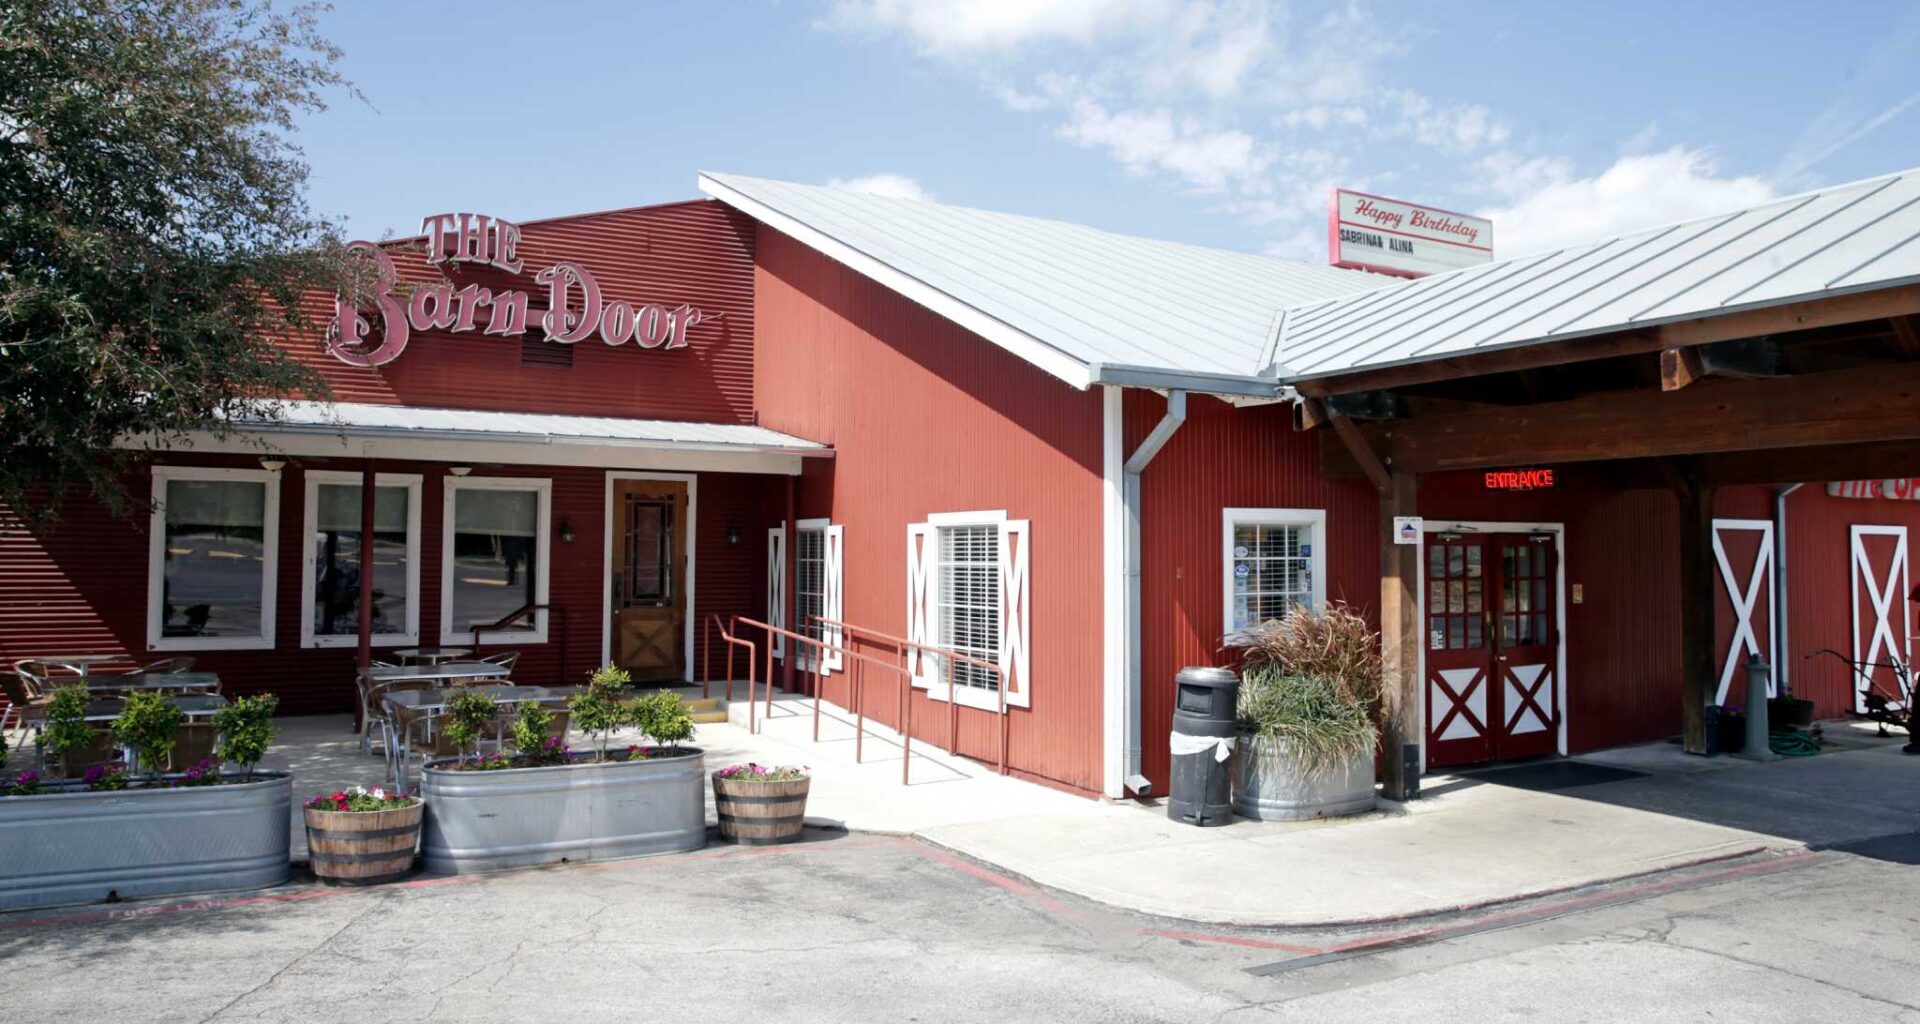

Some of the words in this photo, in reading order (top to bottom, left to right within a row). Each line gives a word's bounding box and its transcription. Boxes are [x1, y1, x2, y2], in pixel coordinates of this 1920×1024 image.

[1355, 199, 1404, 229] Happy
[1409, 209, 1478, 242] Birthday
[420, 212, 524, 275] THE
[1389, 238, 1414, 255] ALINA
[326, 240, 529, 367] Barn
[535, 261, 702, 351] Door
[1485, 469, 1554, 489] ENTRANCE
